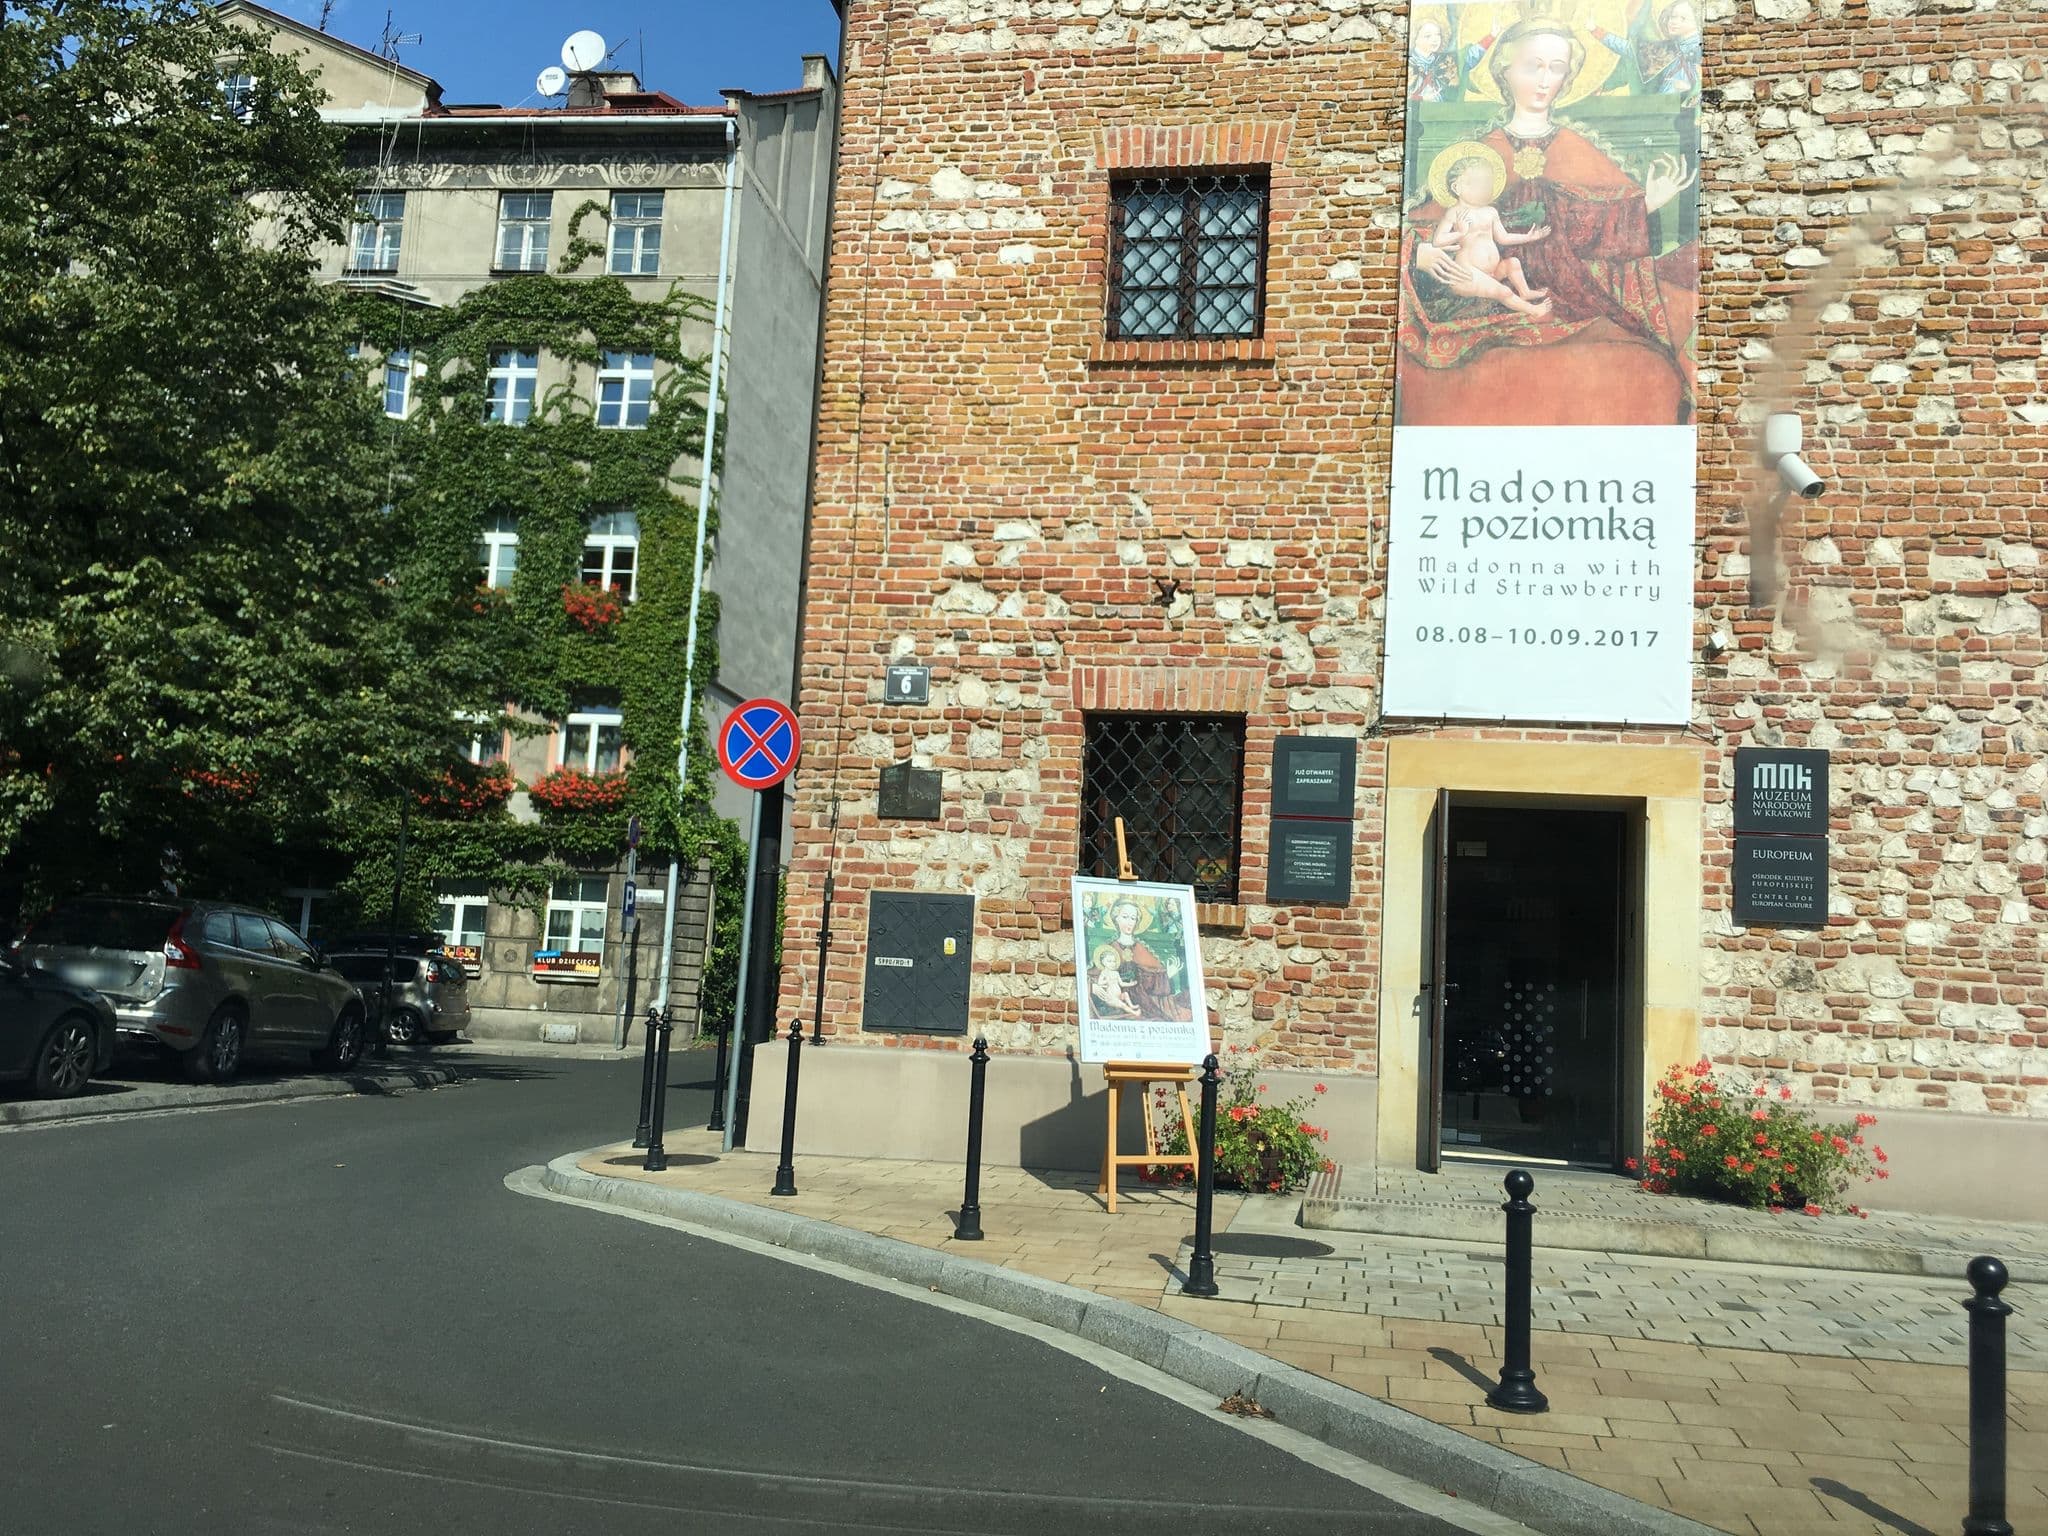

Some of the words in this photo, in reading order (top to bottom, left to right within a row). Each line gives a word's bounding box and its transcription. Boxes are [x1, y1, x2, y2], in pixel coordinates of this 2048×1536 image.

[1422, 467, 1656, 504] Madonna
[1419, 515, 1439, 539] z
[1461, 506, 1657, 550] poziomką
[1418, 556, 1565, 575] Madonna
[1587, 559, 1661, 576] with
[1418, 578, 1476, 595] Wild
[1496, 579, 1661, 602] Strawberry
[901, 675, 912, 694] 6
[1752, 791, 1812, 802] MUZEUM
[1752, 800, 1812, 811] NARODOWE
[1752, 809, 1762, 817] W
[1765, 809, 1812, 819] KRAKOWIE
[1752, 850, 1813, 861] EUROPEUM
[1751, 873, 1783, 881] OŚRODEK
[1751, 880, 1813, 890] EUROPEJSKIEJ
[1089, 1021, 1137, 1033] Madonna
